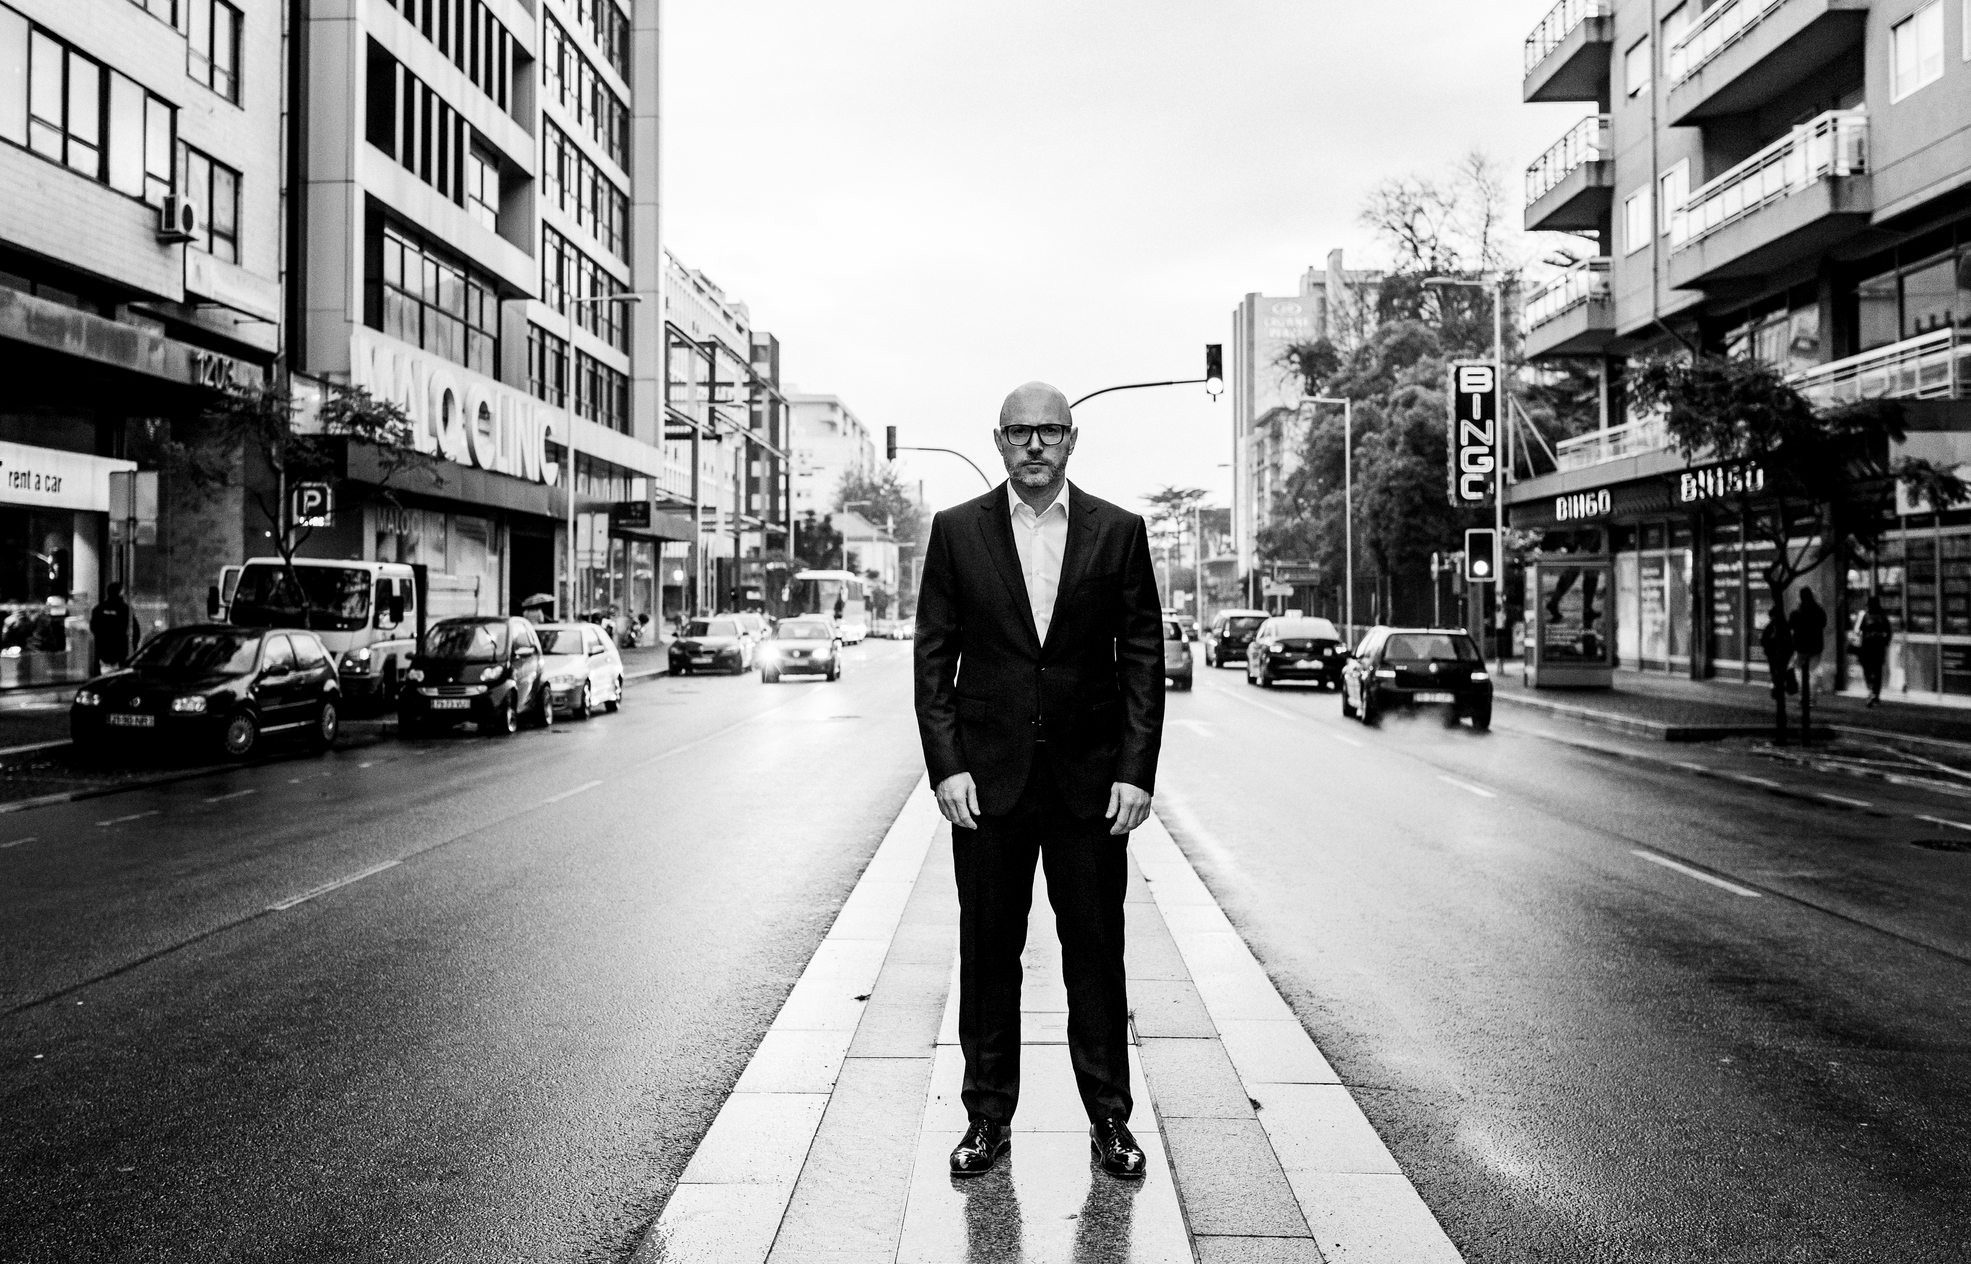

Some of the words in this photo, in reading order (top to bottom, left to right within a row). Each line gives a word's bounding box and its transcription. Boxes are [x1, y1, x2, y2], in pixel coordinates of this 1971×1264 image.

[464, 382, 558, 487] CLINIC
[1460, 366, 1494, 500] BINGO
[9, 469, 31, 490] rent
[34, 473, 41, 491] a
[44, 474, 62, 493] car
[303, 490, 322, 515] P
[1556, 488, 1611, 521] BINGO
